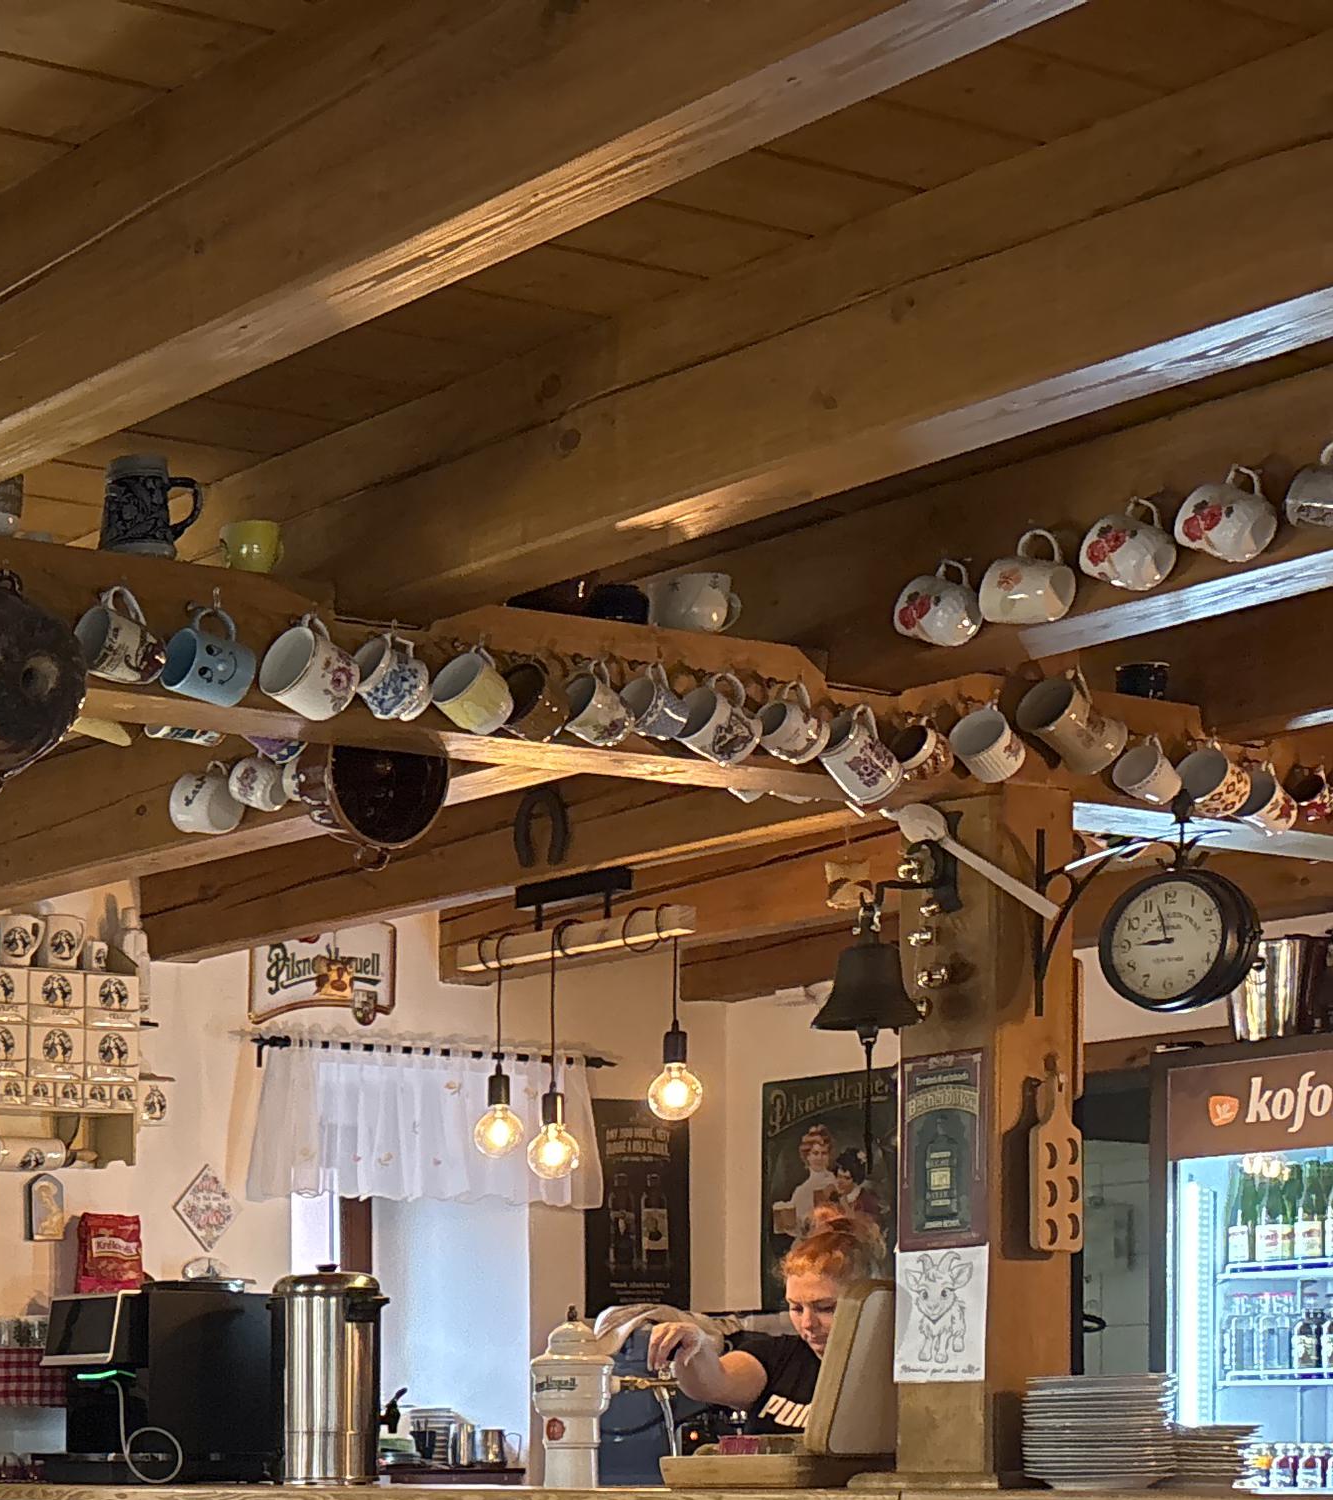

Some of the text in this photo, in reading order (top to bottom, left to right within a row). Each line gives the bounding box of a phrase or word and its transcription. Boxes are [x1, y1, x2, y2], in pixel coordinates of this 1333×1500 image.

[1164, 890, 1178, 904] 12
[1191, 894, 1195, 908] 1
[1144, 900, 1153, 913] 11
[1203, 907, 1213, 922] 2
[1127, 917, 1140, 931] 10
[1121, 939, 1132, 953] 9
[1202, 951, 1211, 965] 4
[266, 942, 319, 995] Pilsn
[1187, 969, 1196, 981] 5
[1142, 974, 1151, 988] 7
[1163, 980, 1174, 991] 6
